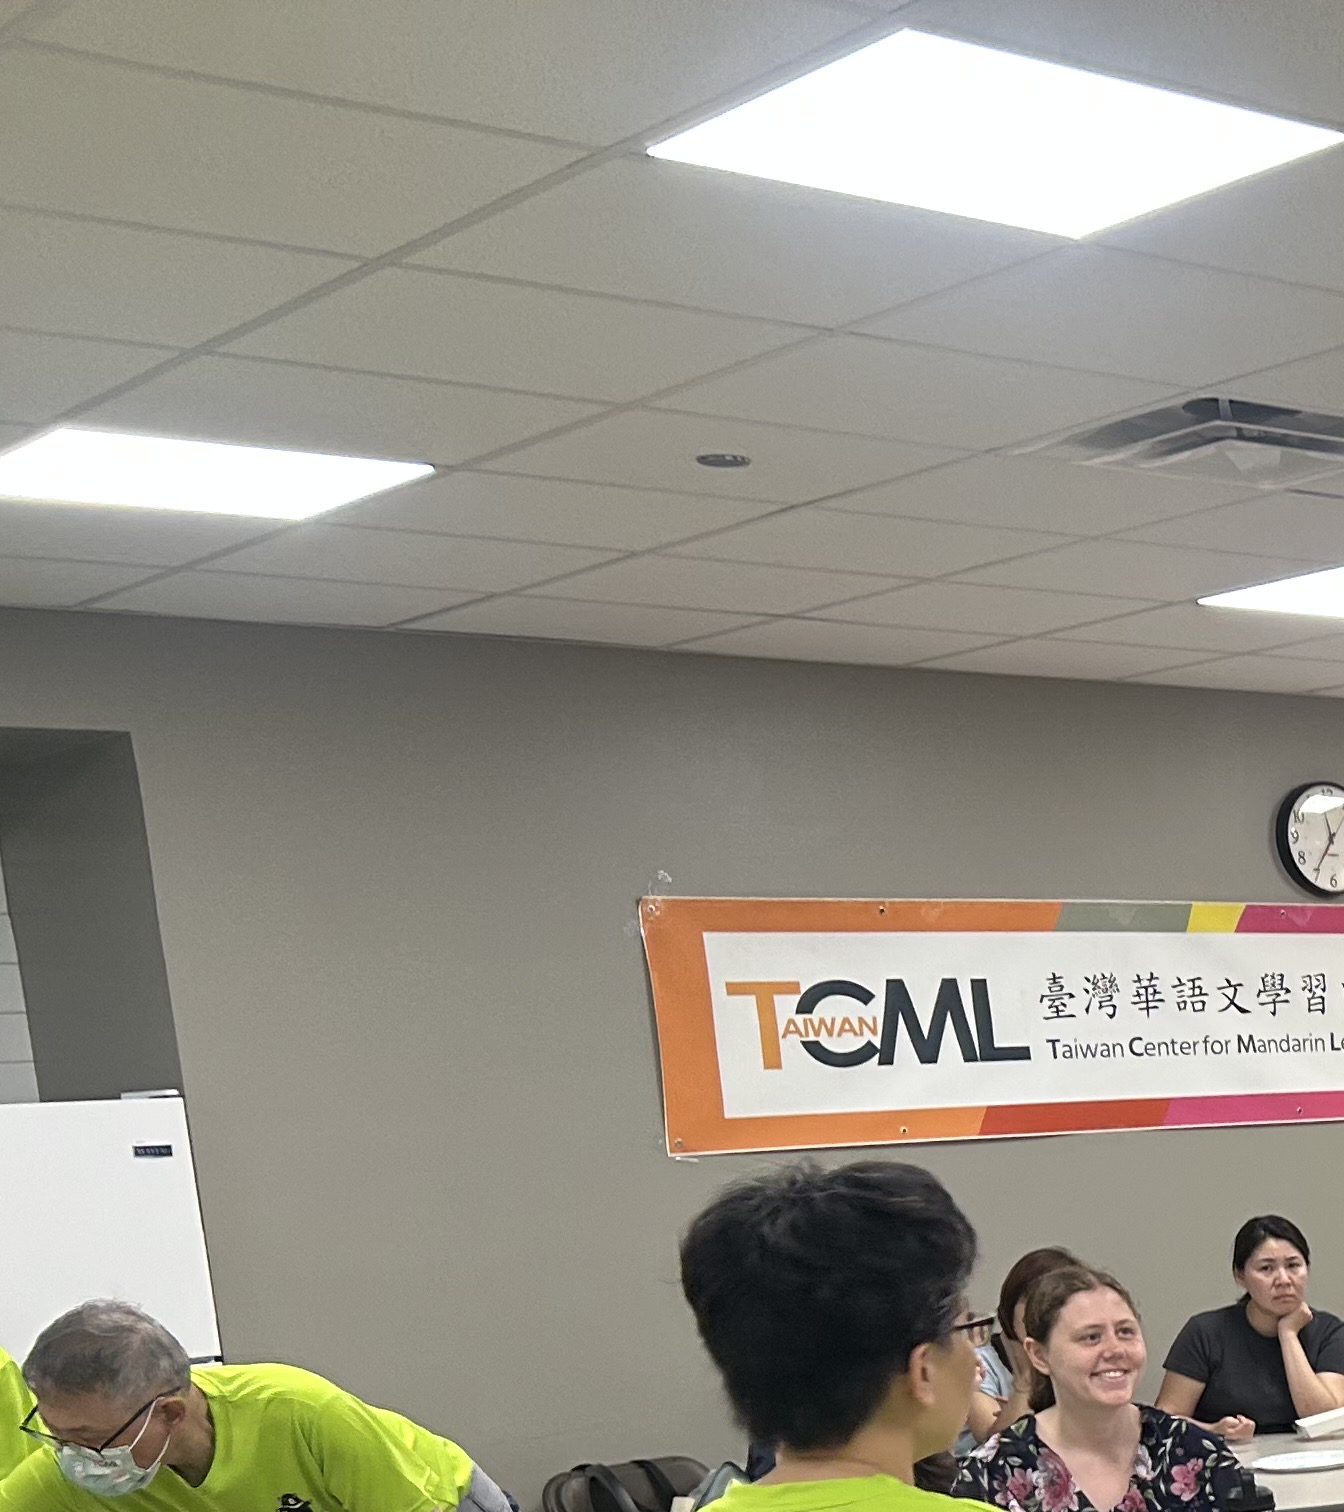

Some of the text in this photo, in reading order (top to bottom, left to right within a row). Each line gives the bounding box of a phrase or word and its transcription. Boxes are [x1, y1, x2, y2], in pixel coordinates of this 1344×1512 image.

[1291, 828, 1299, 844] 9
[1298, 851, 1306, 865] 8
[1330, 874, 1337, 887] 6
[1046, 1038, 1124, 1061] Taiwan
[1129, 1036, 1199, 1057] Center
[1201, 1034, 1231, 1055] for
[1237, 1032, 1325, 1055] Mandarin
